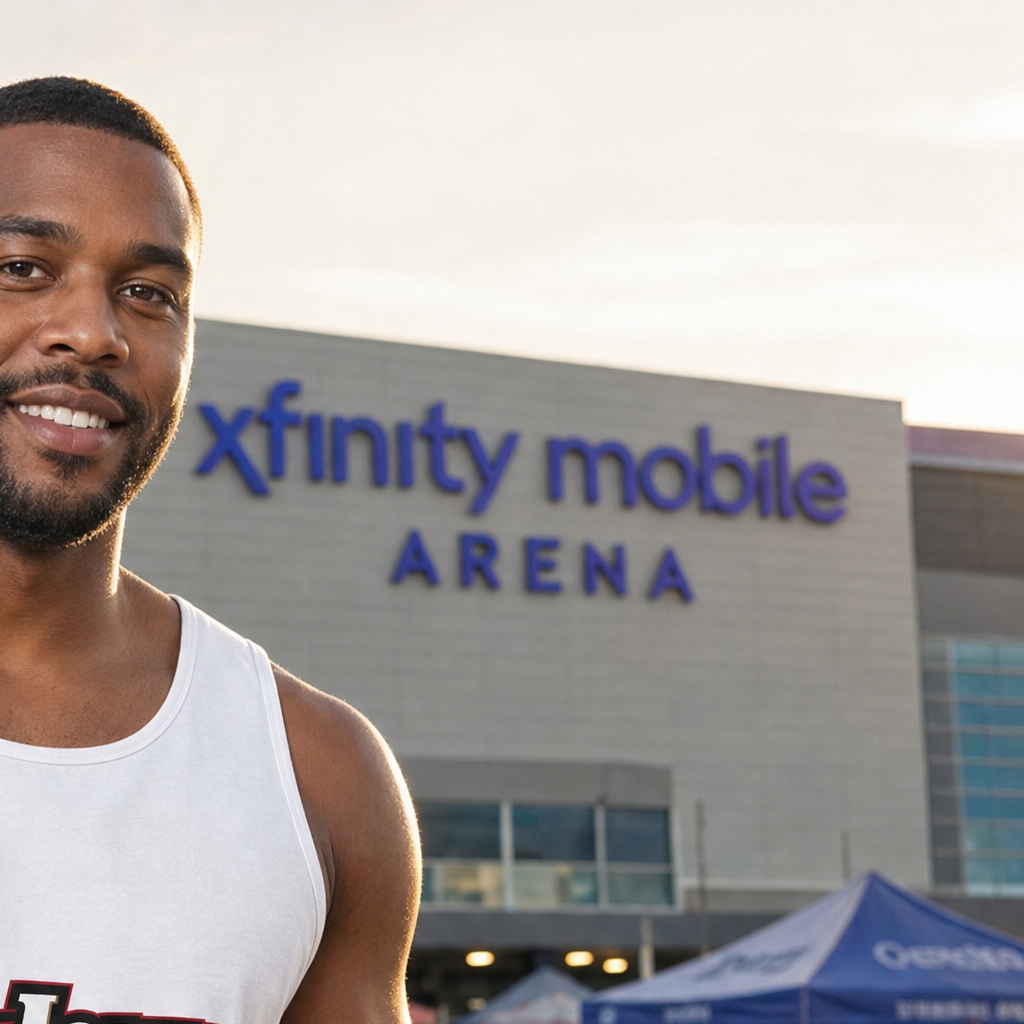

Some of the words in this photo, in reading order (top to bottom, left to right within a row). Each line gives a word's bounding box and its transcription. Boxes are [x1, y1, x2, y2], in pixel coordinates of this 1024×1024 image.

[195, 379, 519, 515] xfinity
[547, 425, 848, 524] mobile
[391, 529, 694, 600] ARENA
